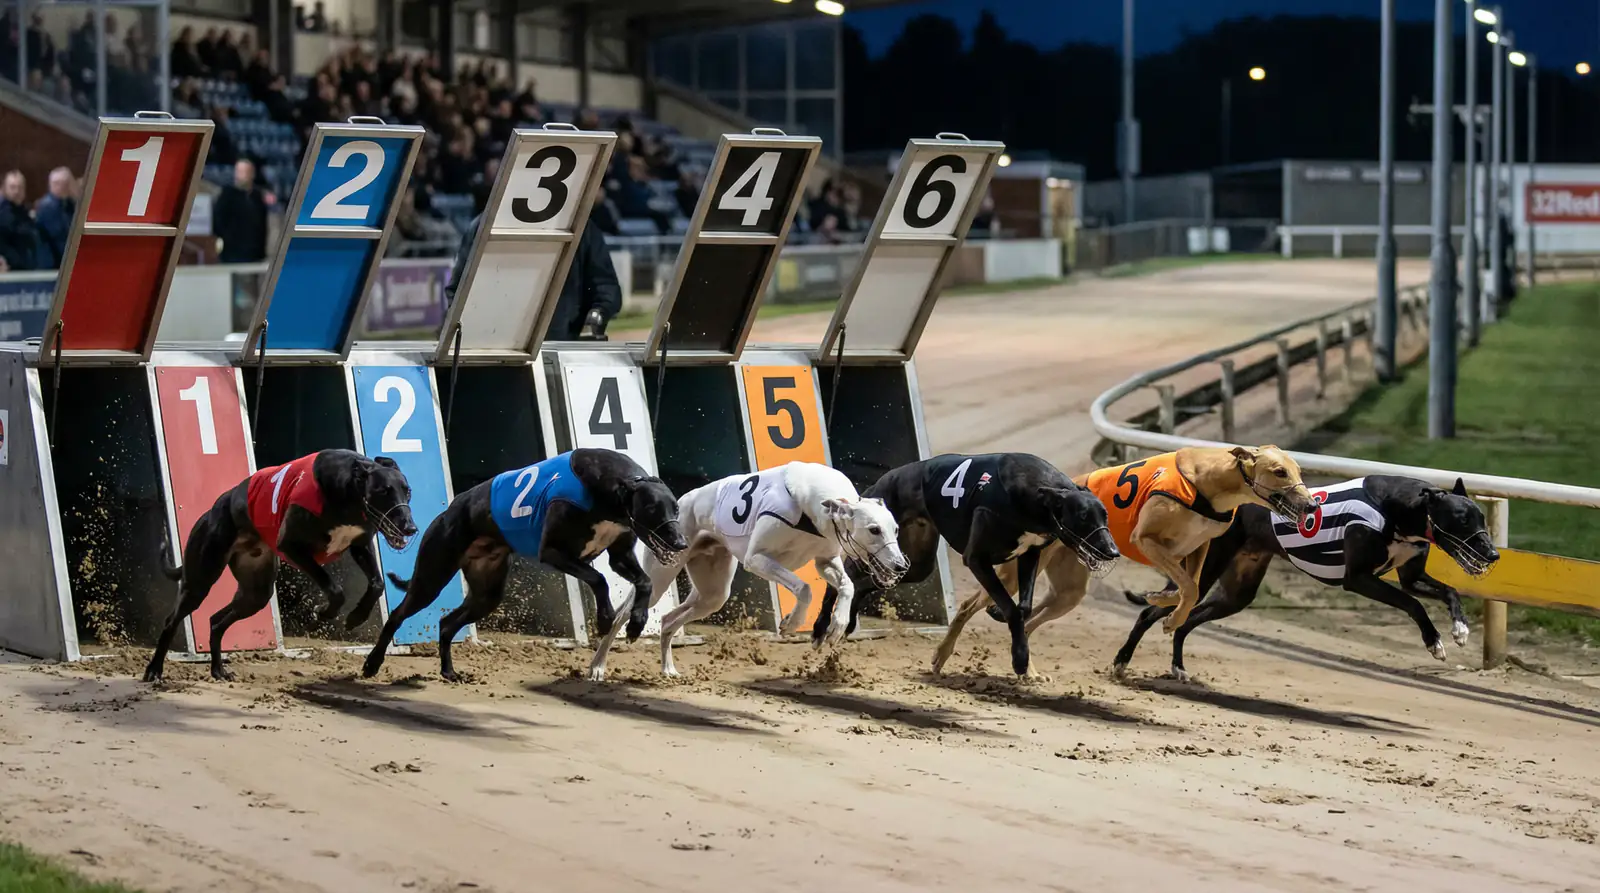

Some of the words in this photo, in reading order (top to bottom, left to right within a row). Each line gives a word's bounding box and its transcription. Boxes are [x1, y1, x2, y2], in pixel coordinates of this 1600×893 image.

[120, 136, 165, 217] 1
[311, 140, 386, 220] 2
[512, 145, 577, 223] 3
[717, 151, 782, 226] 4
[903, 154, 968, 229] 6
[1531, 189, 1599, 215] 32Red
[179, 376, 219, 455] 1
[373, 375, 424, 453] 2
[588, 377, 632, 450] 4
[762, 376, 806, 450] 5
[270, 463, 293, 514] 1
[510, 466, 540, 519] 2
[731, 474, 760, 525] 3
[940, 458, 973, 509] 4
[1113, 460, 1147, 509] 5
